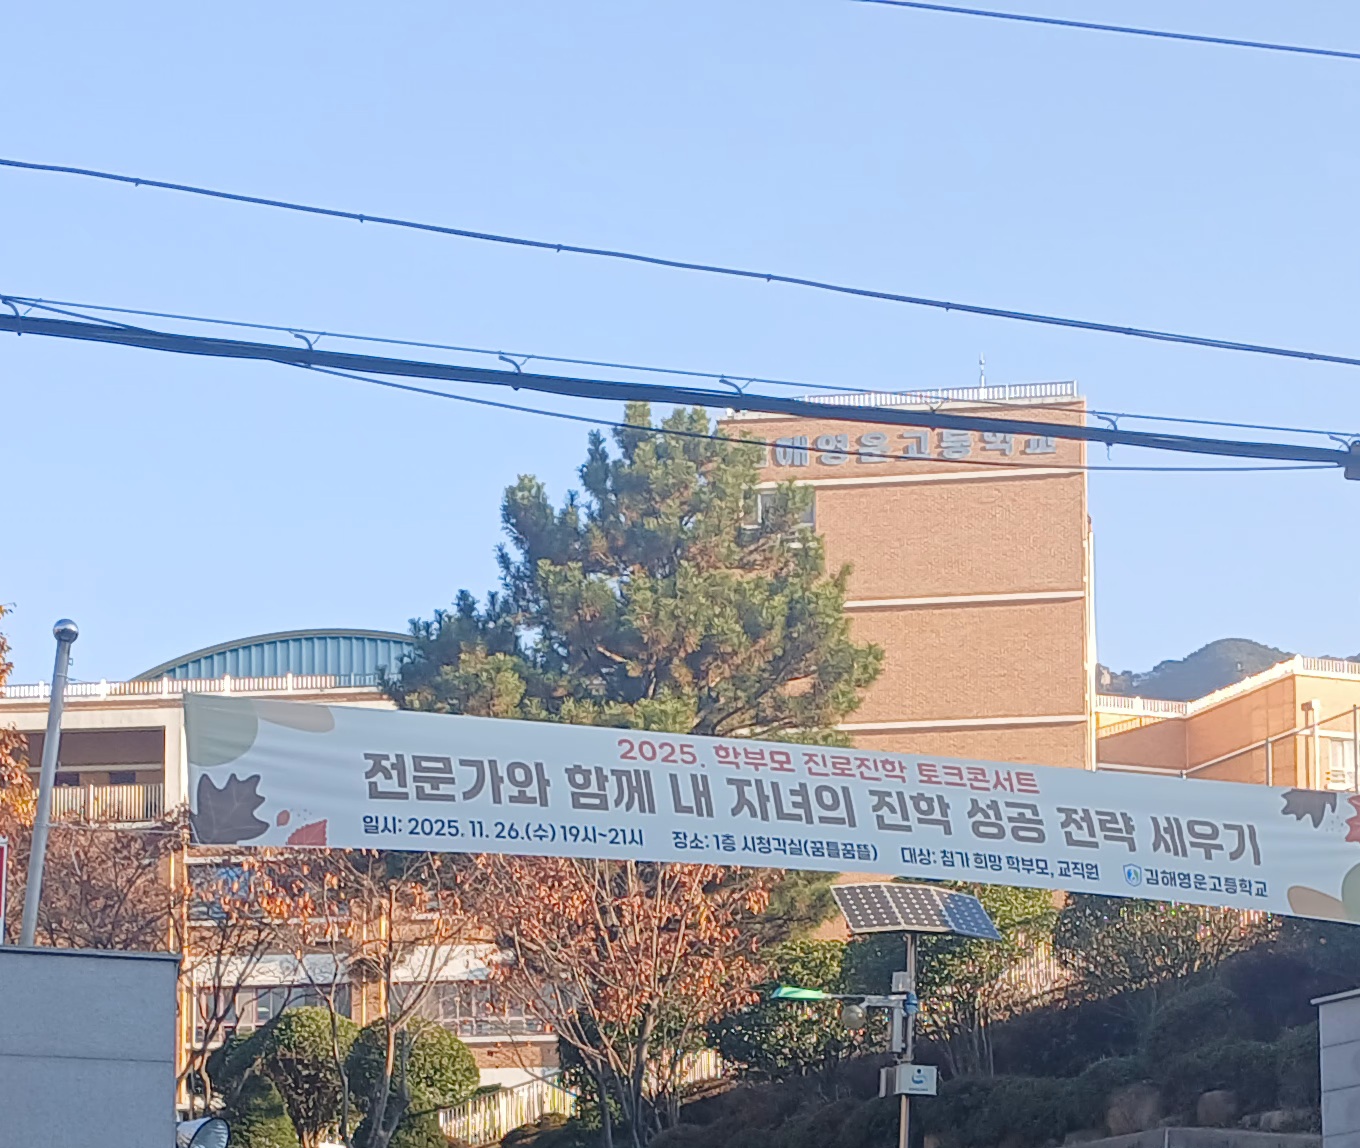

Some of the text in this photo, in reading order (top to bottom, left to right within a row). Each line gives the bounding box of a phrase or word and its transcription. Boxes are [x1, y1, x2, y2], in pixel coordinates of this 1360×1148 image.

[752, 429, 1057, 469] 해영운고등학교
[617, 739, 1041, 795] 2025. 학부모 진로진학 토크콘서트
[363, 752, 1262, 866] 전문가와 함께 내 자녀의 진학 성공 전략 세우기
[362, 815, 403, 837] 일시:
[408, 818, 464, 839] 2025.
[672, 831, 710, 850] 장소:
[713, 834, 737, 852] 1층
[900, 846, 938, 865] 대상:
[974, 851, 1004, 872] 희망
[1005, 854, 1055, 876] 학부모,
[1057, 860, 1101, 881] 교직원
[1143, 868, 1270, 898] 김해영운고등학교
